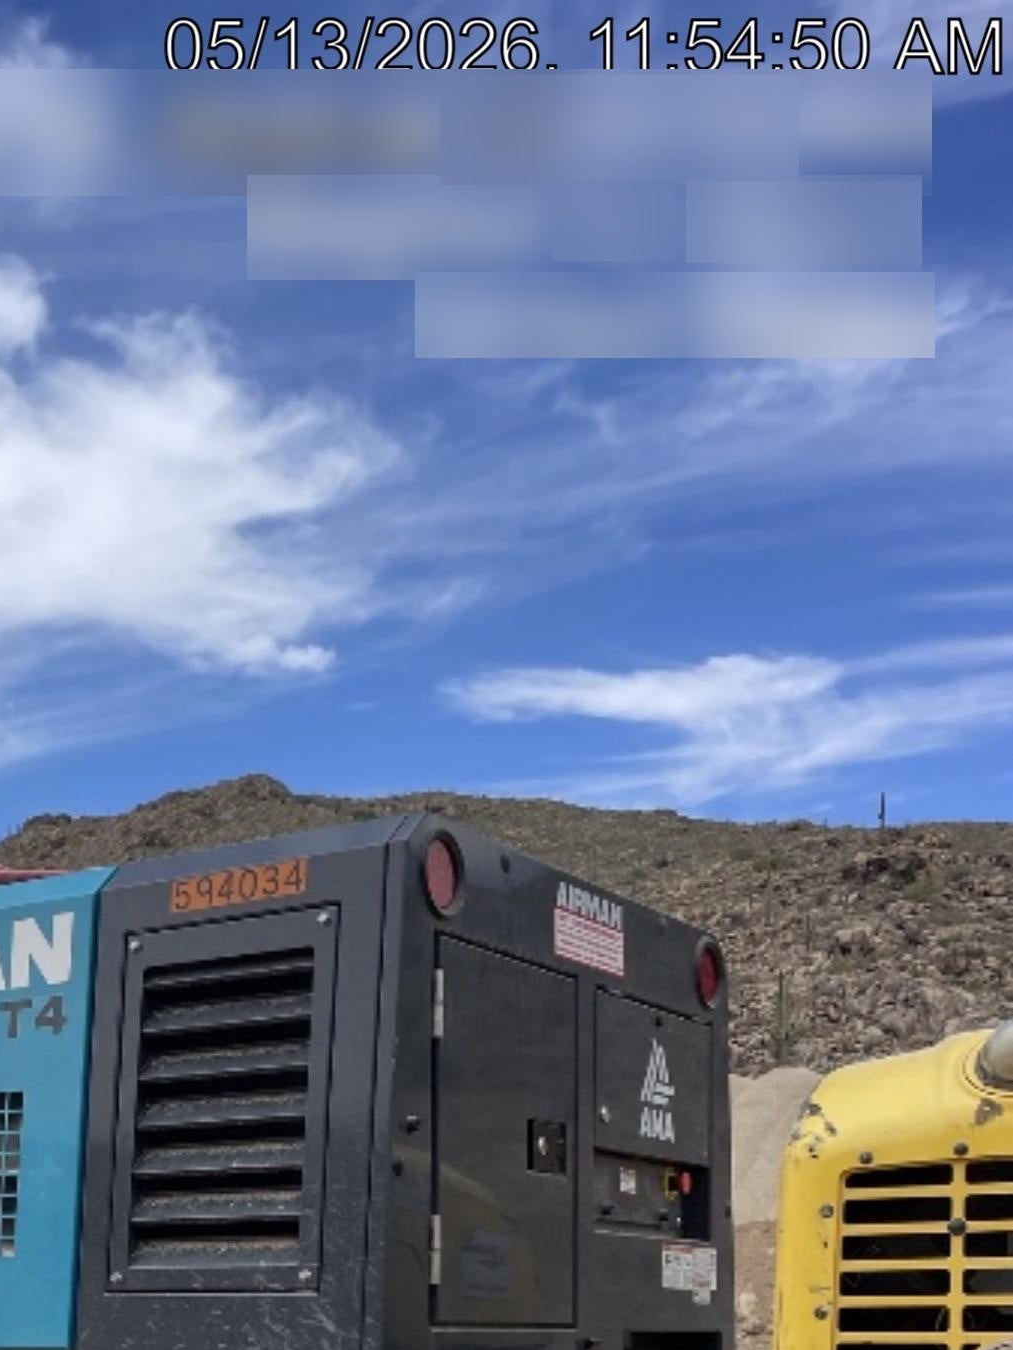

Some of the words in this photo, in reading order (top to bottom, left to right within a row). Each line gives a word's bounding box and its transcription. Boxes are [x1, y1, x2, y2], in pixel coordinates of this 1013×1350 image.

[174, 858, 303, 911] 594034
[556, 881, 623, 931] AIRMAN
[640, 1107, 676, 1144] ANA
